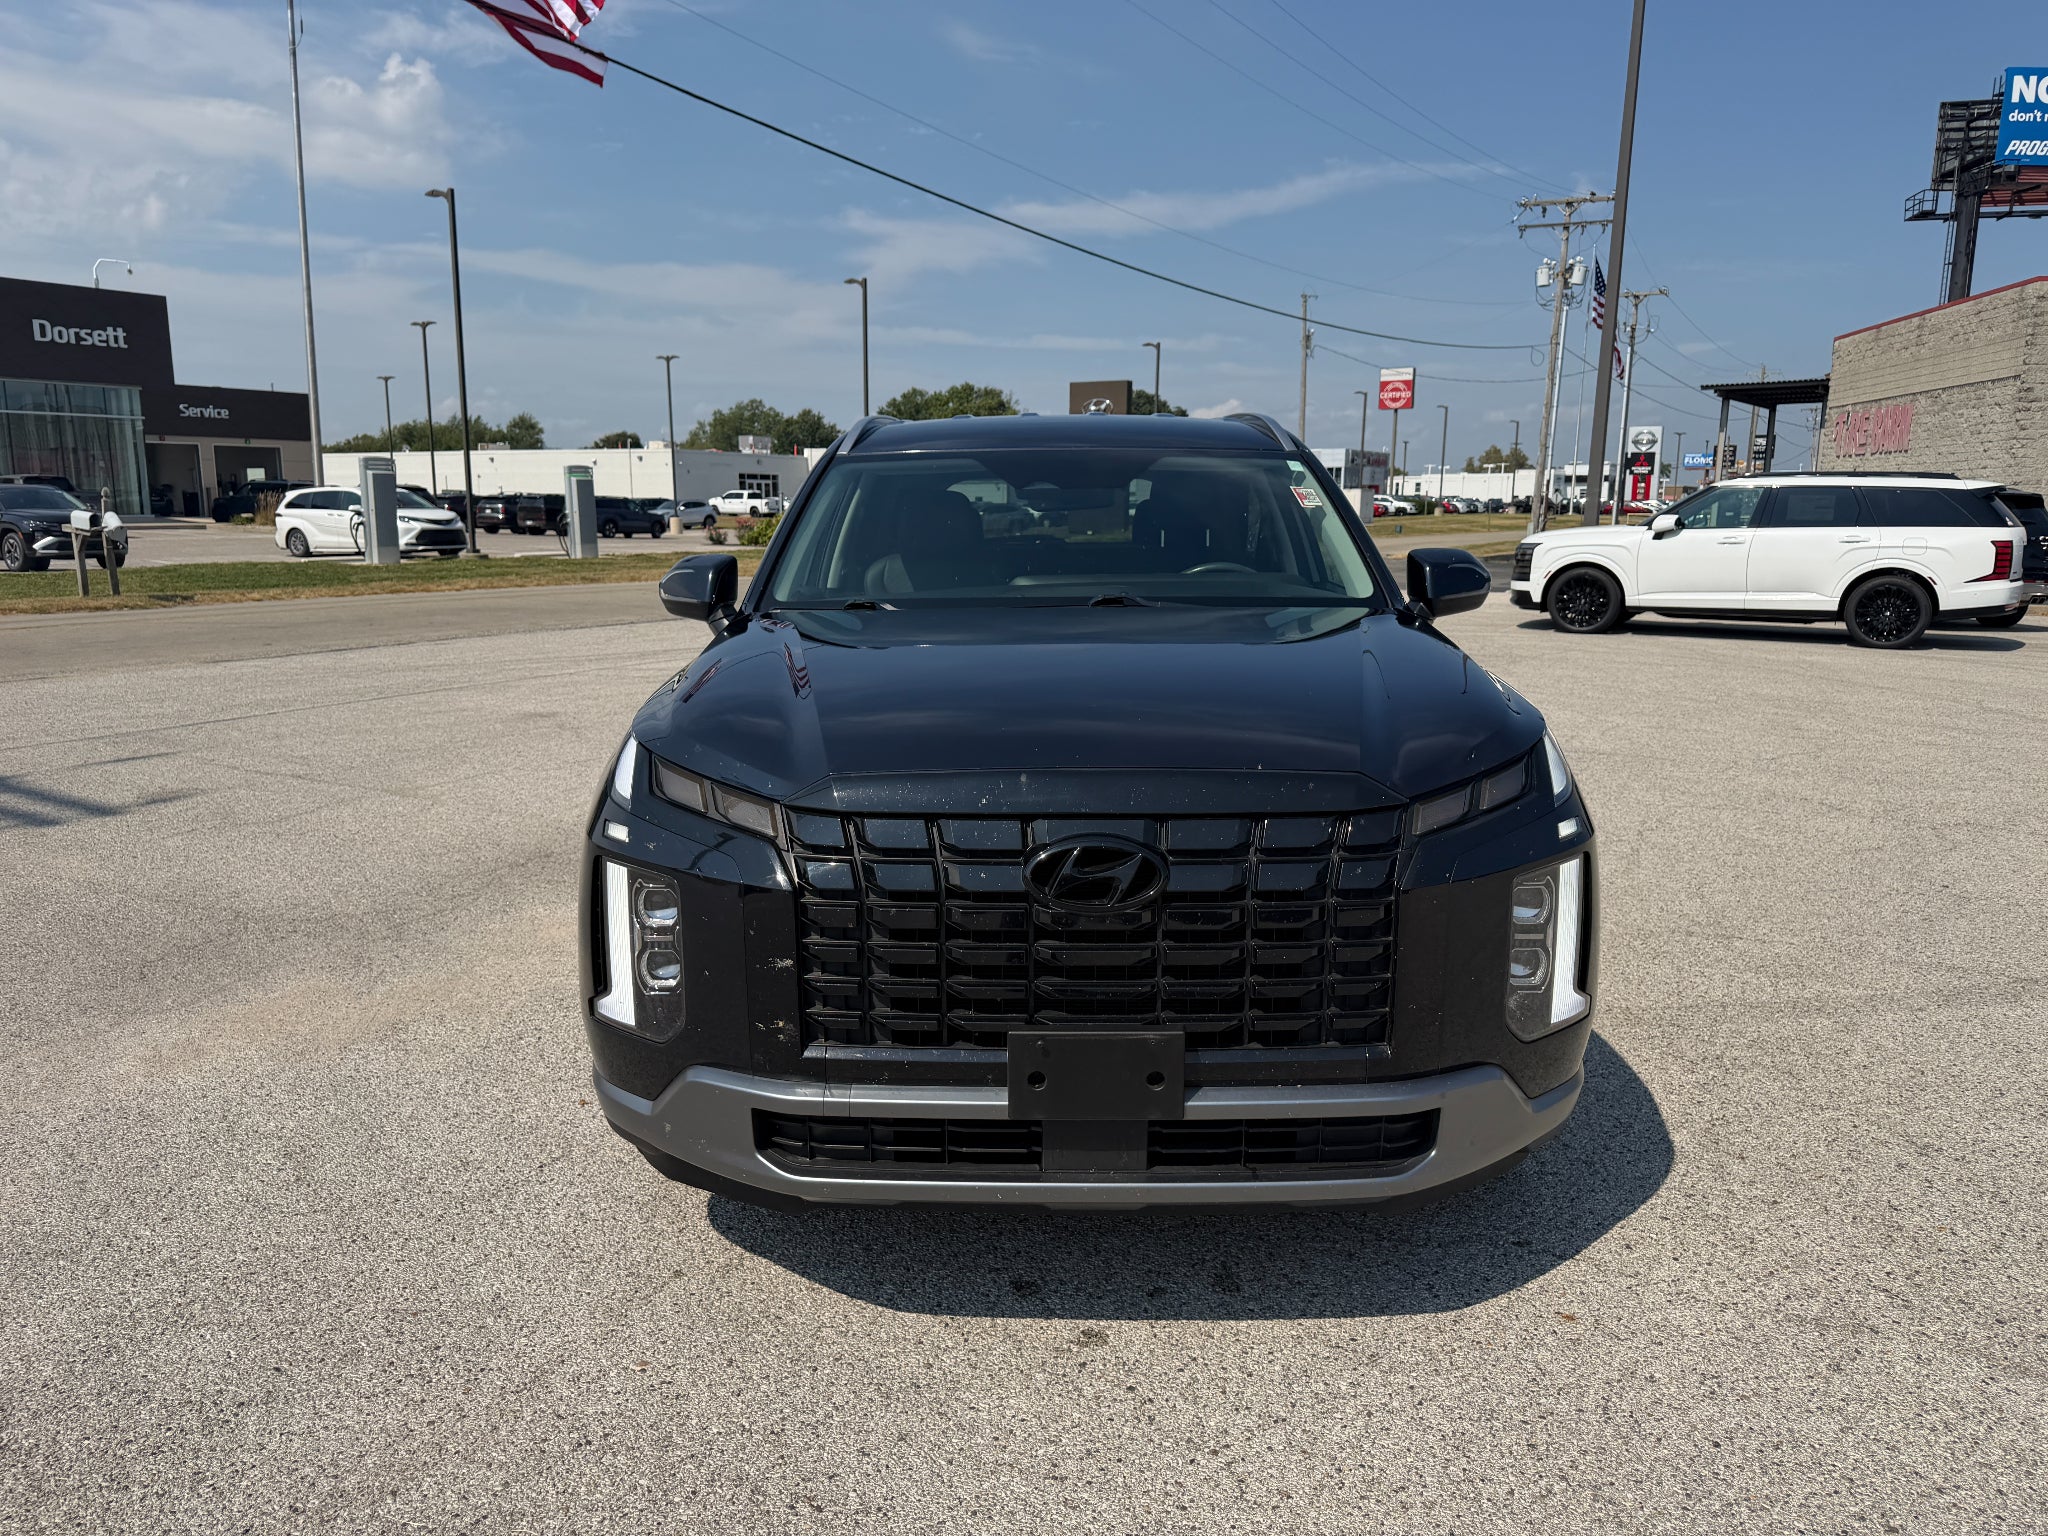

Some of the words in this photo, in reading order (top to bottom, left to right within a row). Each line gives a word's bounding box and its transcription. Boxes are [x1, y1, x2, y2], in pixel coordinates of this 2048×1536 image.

[2008, 109, 2043, 122] don't
[32, 318, 128, 349] Dorsett
[179, 403, 230, 420] Service
[1871, 404, 1913, 455] BARN
